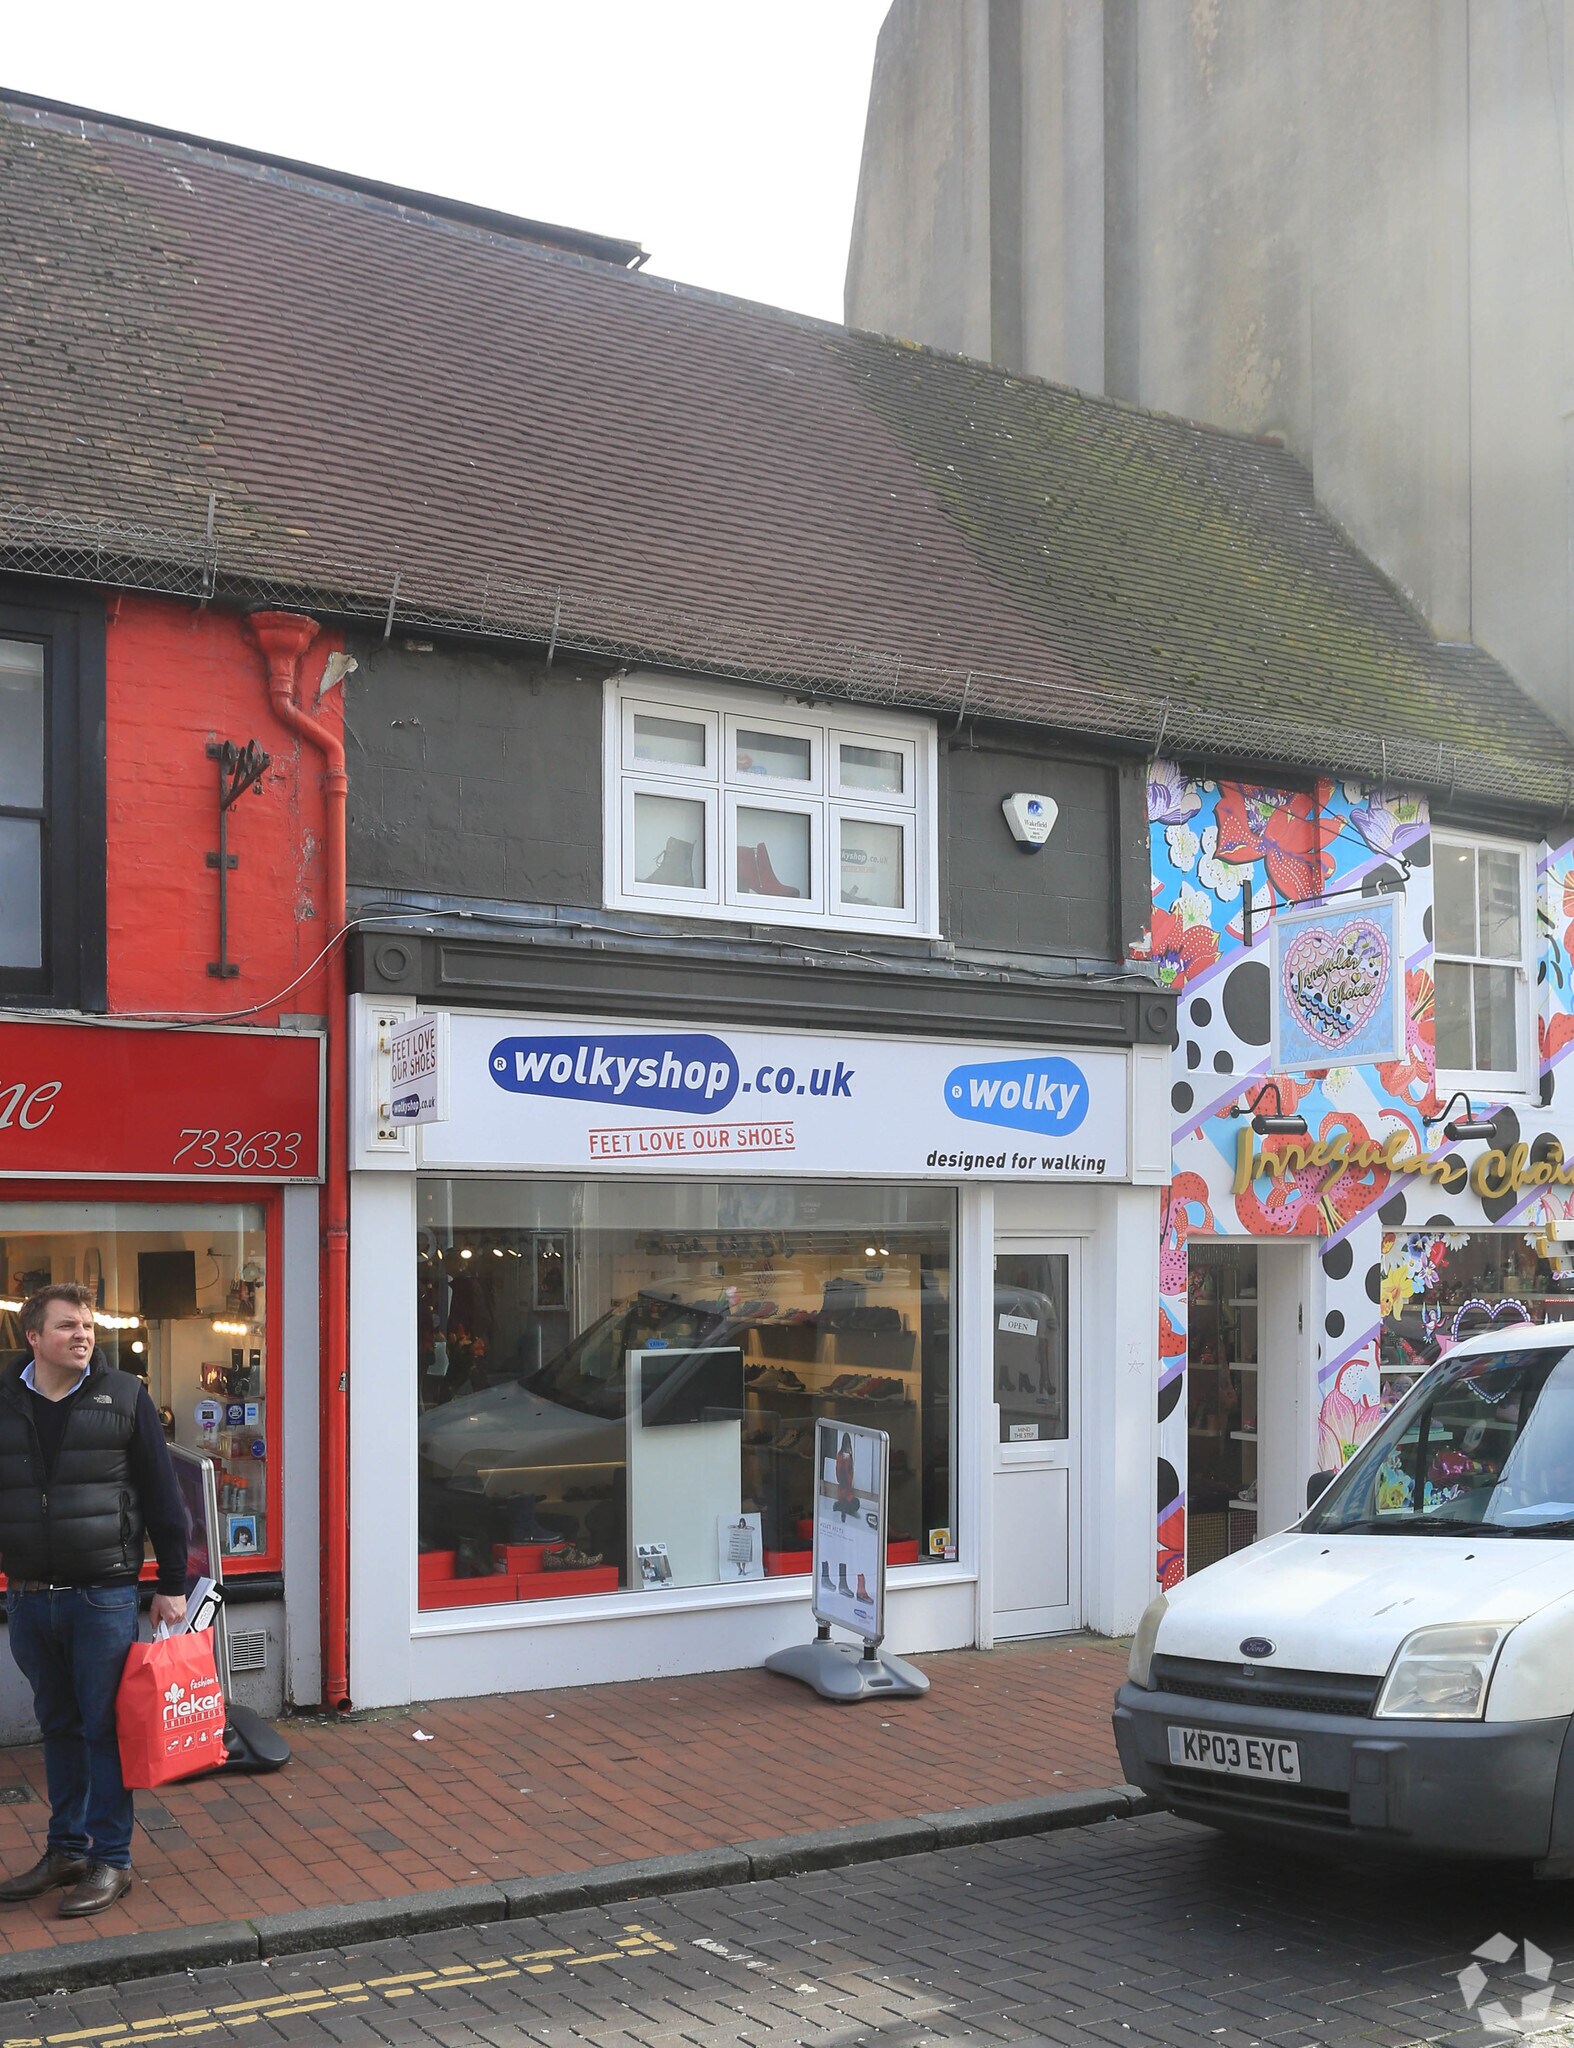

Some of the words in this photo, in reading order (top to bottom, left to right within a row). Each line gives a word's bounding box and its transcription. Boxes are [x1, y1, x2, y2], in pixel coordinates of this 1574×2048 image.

[391, 1038, 411, 1062] FEET
[413, 1028, 435, 1055] LOVE
[391, 1061, 408, 1082] OUR
[410, 1050, 436, 1076] SHOES
[968, 1073, 1081, 1120] wolky
[172, 1128, 303, 1170] 733633
[589, 1134, 631, 1154] FEET
[639, 1131, 685, 1152] LOVE
[692, 1130, 730, 1148] OUR
[737, 1128, 795, 1146] SHOES
[926, 1150, 1006, 1171] designed
[1011, 1152, 1037, 1169] for
[1041, 1154, 1106, 1174] walking
[1232, 1126, 1468, 1195] Irregular
[1470, 1142, 1574, 1199] Choi
[1007, 1320, 1029, 1331] OPEN
[1246, 1641, 1267, 1653] Ford
[190, 1676, 215, 1690] fashion
[163, 1692, 222, 1721] rieker
[1183, 1731, 1241, 1767] KP03
[1245, 1739, 1294, 1775] EYC
